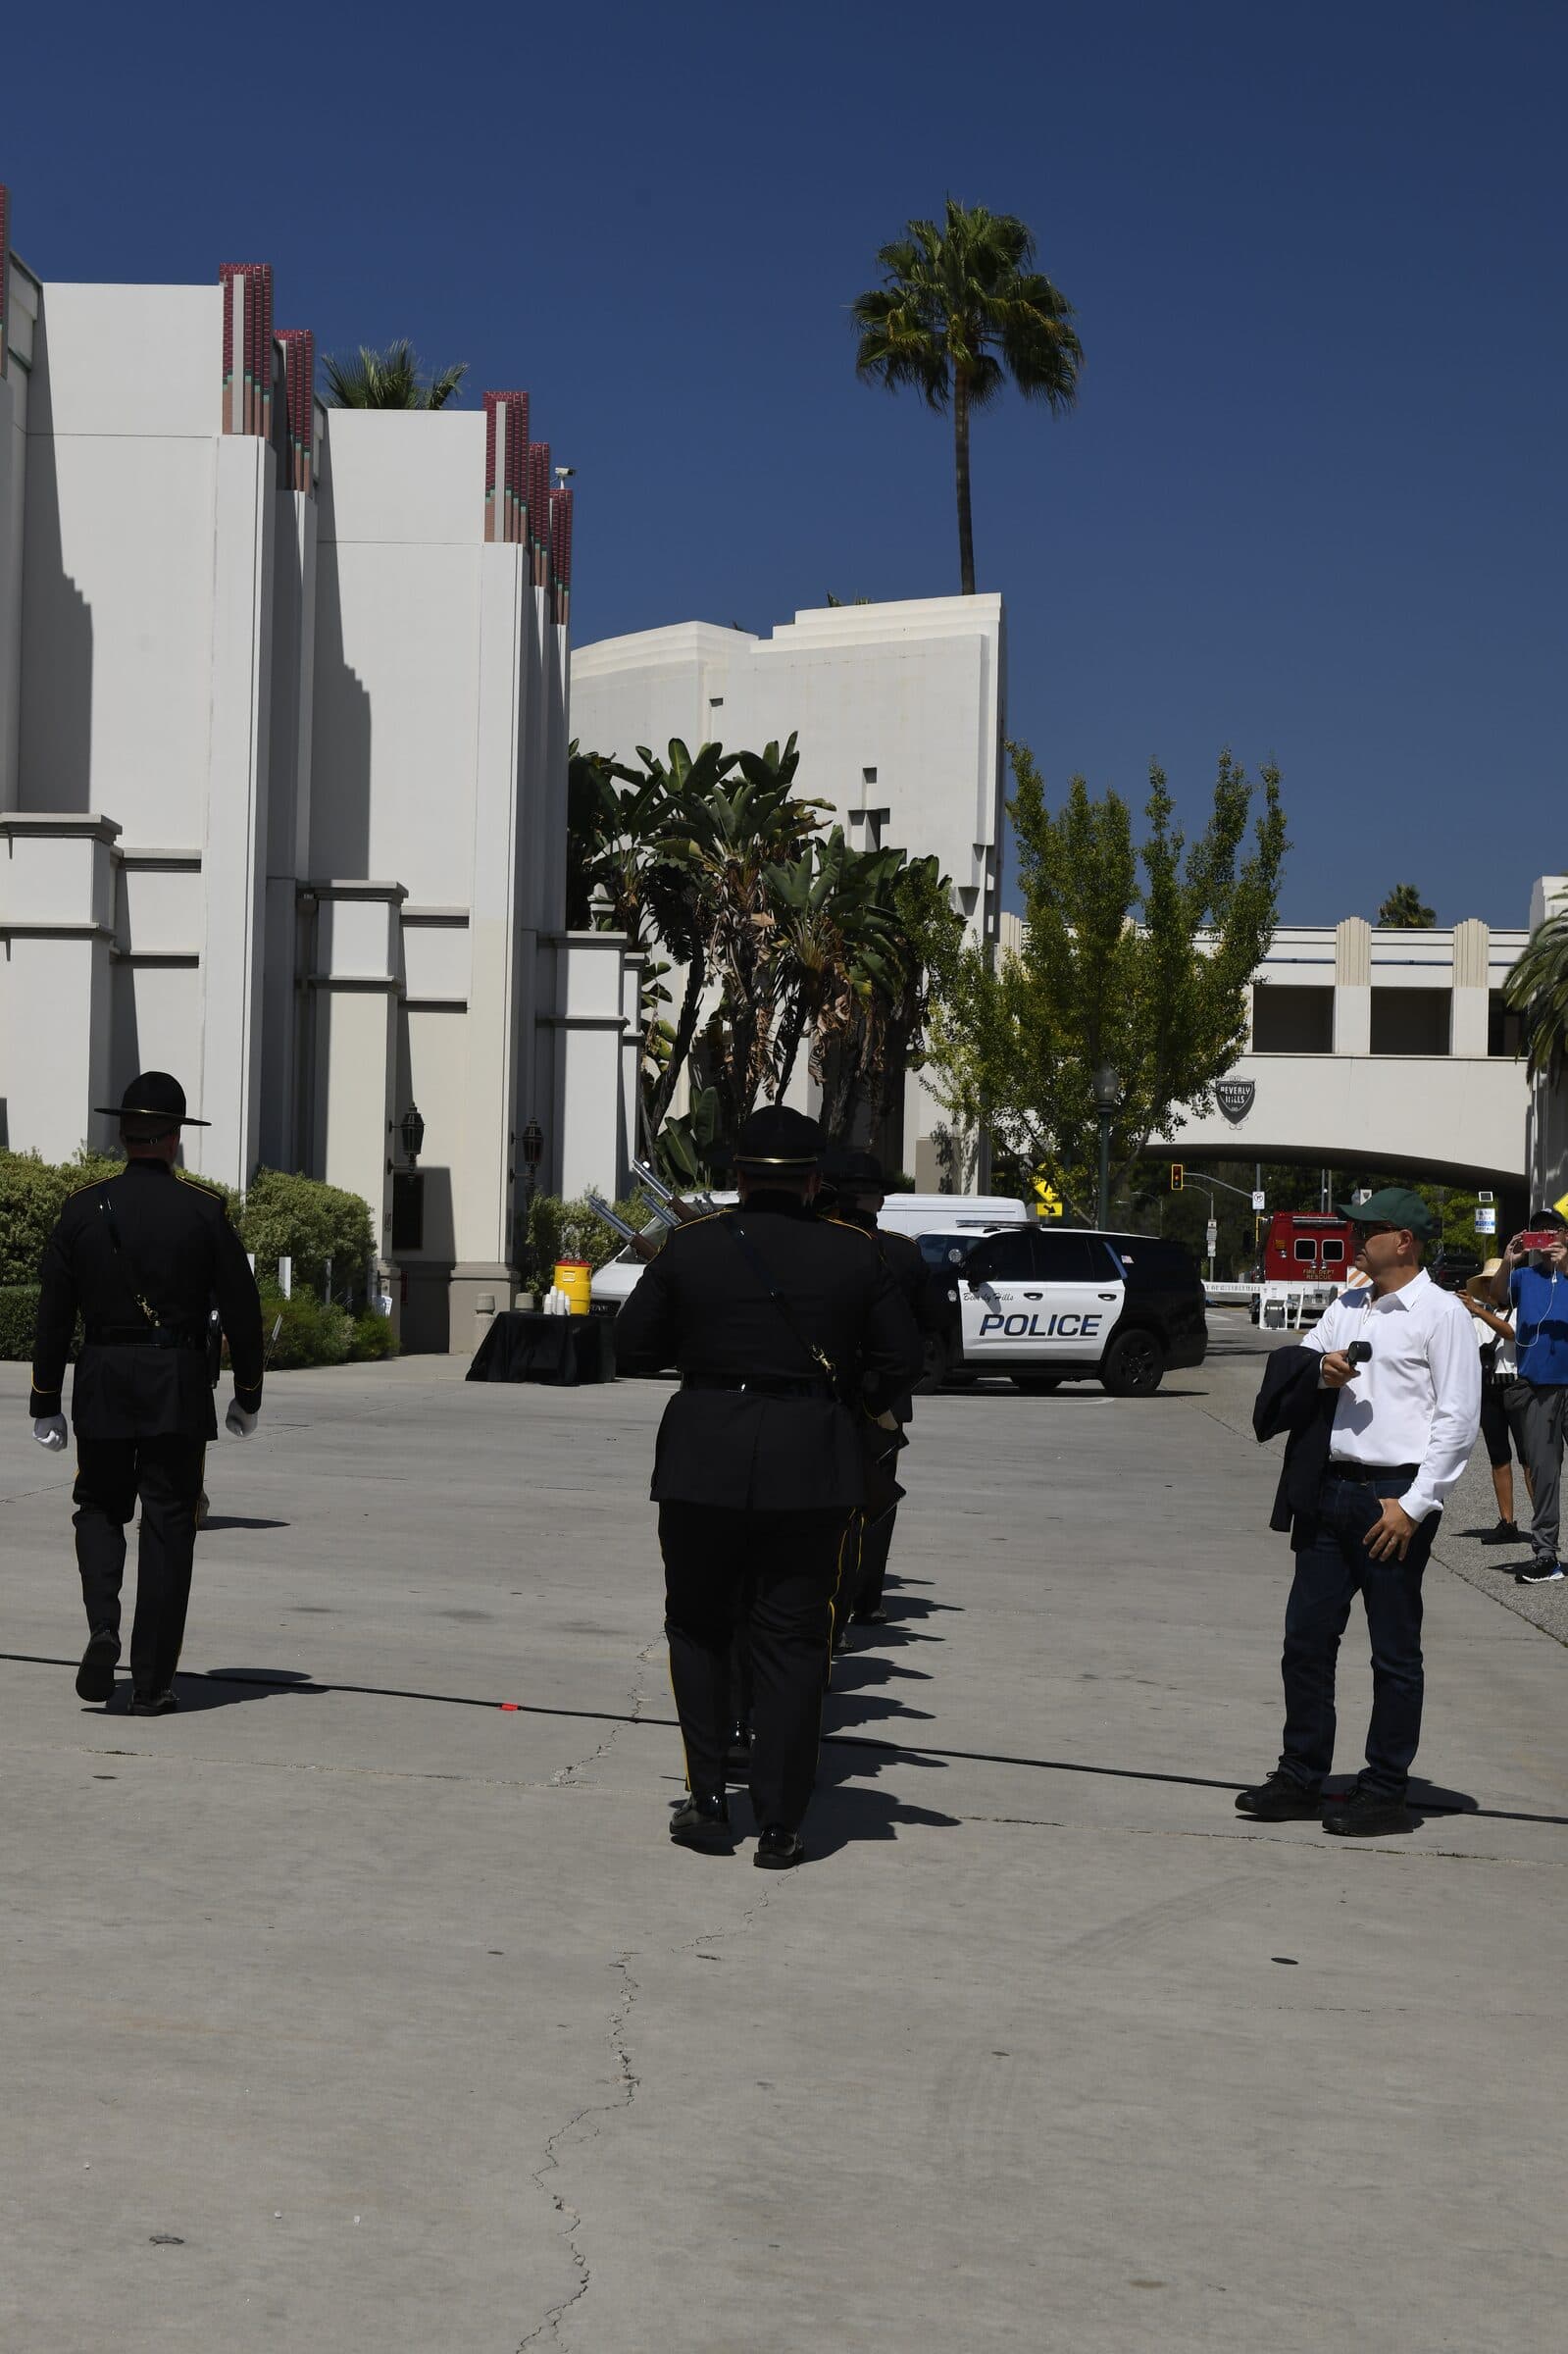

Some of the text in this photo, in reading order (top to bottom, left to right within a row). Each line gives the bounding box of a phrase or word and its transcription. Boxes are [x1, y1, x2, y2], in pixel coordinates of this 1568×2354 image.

[1220, 1086, 1250, 1095] BEVERLY
[1225, 1095, 1244, 1103] HILLS
[994, 1292, 1014, 1301] Hills
[979, 1314, 1102, 1336] POLICE
